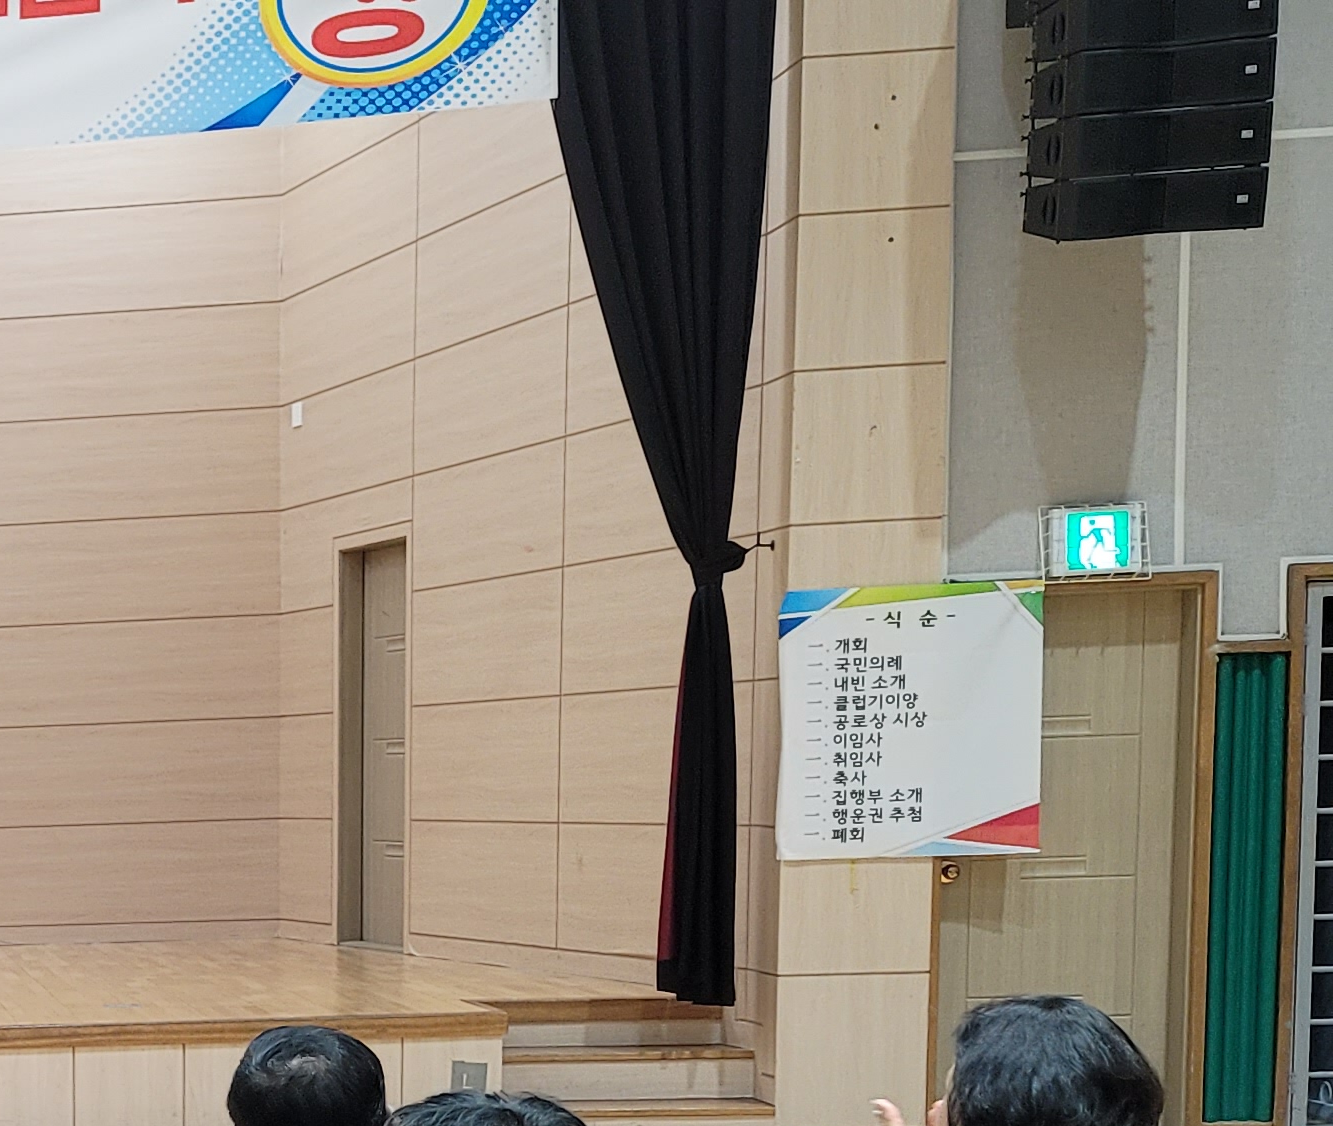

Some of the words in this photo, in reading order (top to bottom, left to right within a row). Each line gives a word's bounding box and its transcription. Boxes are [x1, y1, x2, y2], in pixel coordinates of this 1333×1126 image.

[835, 637, 868, 654] 개회
[834, 655, 902, 673] 국민의례
[834, 676, 865, 692] 내빈
[871, 674, 906, 690] 소개
[834, 693, 918, 711] 클럽기이양
[833, 713, 887, 730] 공로상
[893, 711, 927, 728] 시상
[833, 732, 882, 749] 이임사
[833, 751, 882, 768] 취임사
[833, 770, 867, 786] 축사
[832, 789, 883, 806] 집행부
[889, 787, 923, 803] 소개
[832, 807, 883, 825] 행운권
[889, 806, 922, 823] 추첨
